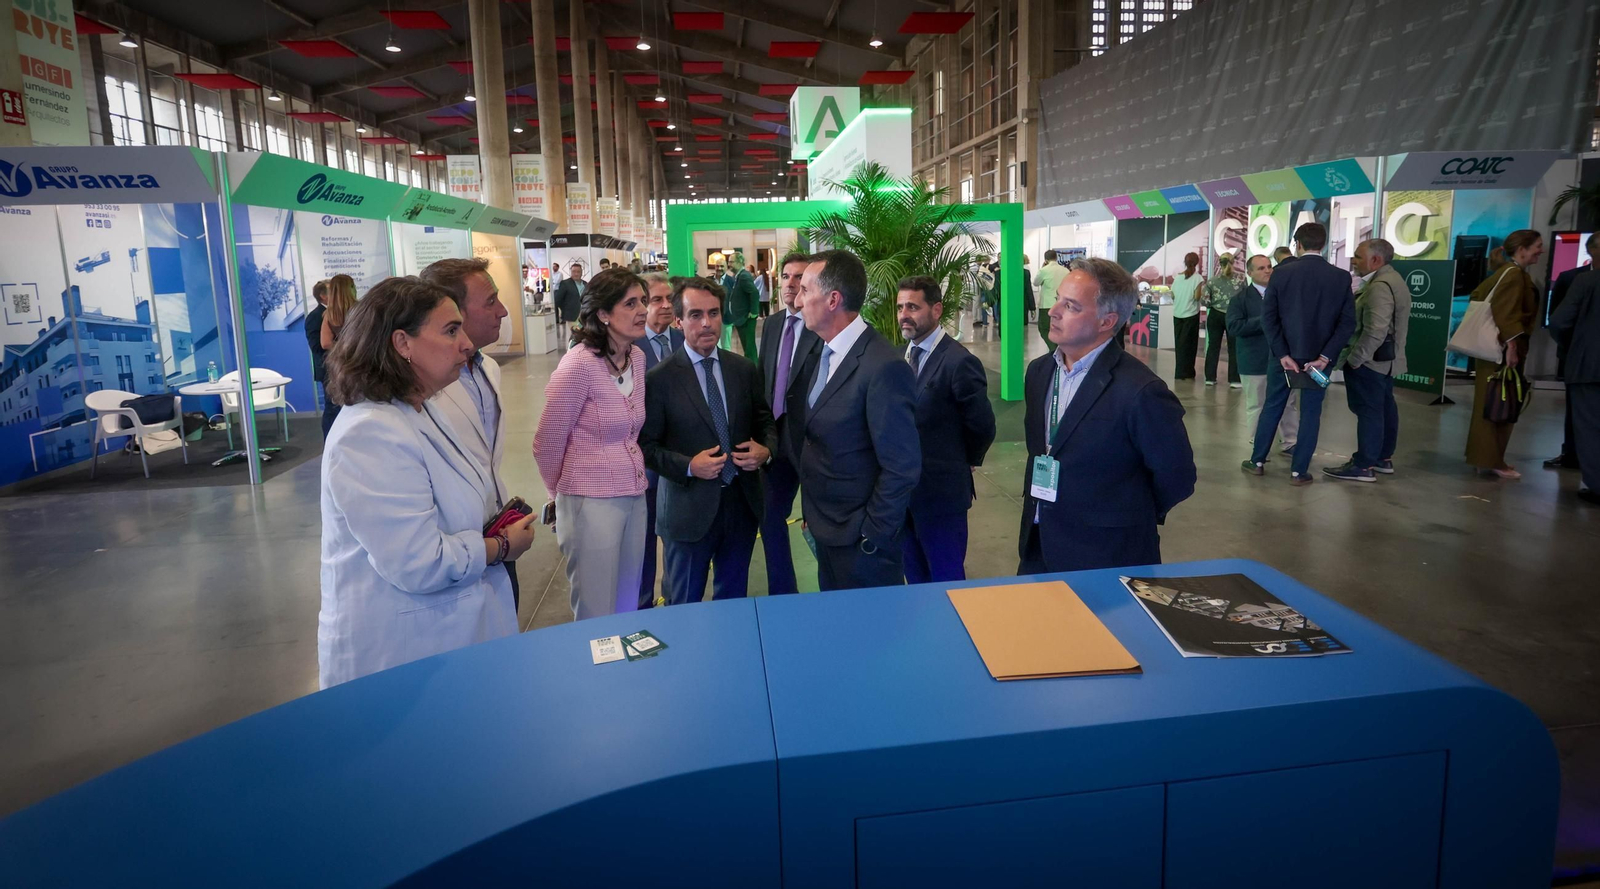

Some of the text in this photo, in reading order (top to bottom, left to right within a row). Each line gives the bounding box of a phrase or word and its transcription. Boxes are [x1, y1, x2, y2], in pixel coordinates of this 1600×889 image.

[24, 81, 71, 101] umersindo
[1441, 157, 1515, 175] COATC
[450, 169, 474, 177] EXPO
[514, 168, 539, 176] EXPO
[32, 166, 160, 189] Avanza
[451, 184, 479, 192] TRUYE
[515, 183, 545, 191] TRUYE
[317, 183, 364, 206] Avanza
[1214, 188, 1240, 198] TÉCNICA
[0, 206, 31, 216] Avanza
[472, 243, 498, 255] egoin
